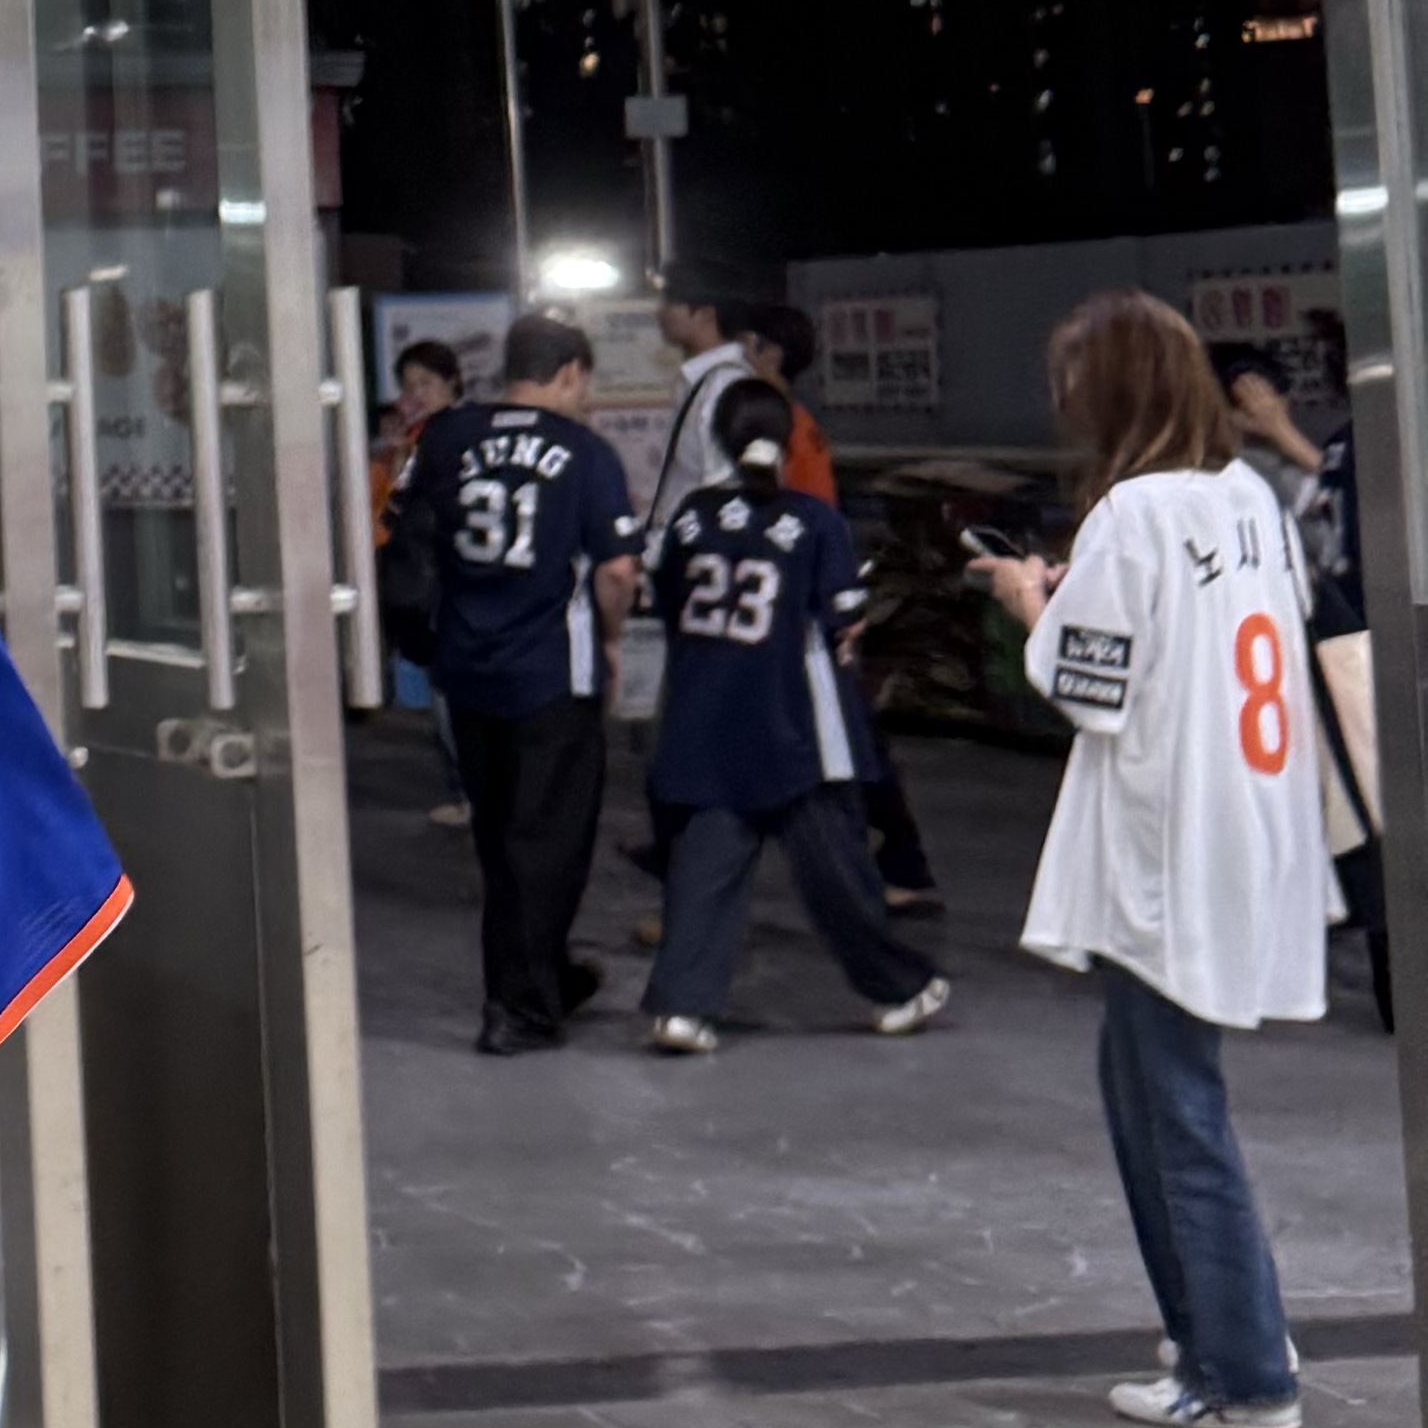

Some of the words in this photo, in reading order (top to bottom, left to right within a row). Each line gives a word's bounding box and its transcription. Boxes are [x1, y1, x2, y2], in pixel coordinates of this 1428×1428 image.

[458, 433, 572, 481] JUNG
[454, 480, 541, 569] 31
[679, 553, 782, 645] 23
[1233, 611, 1291, 777] 8
